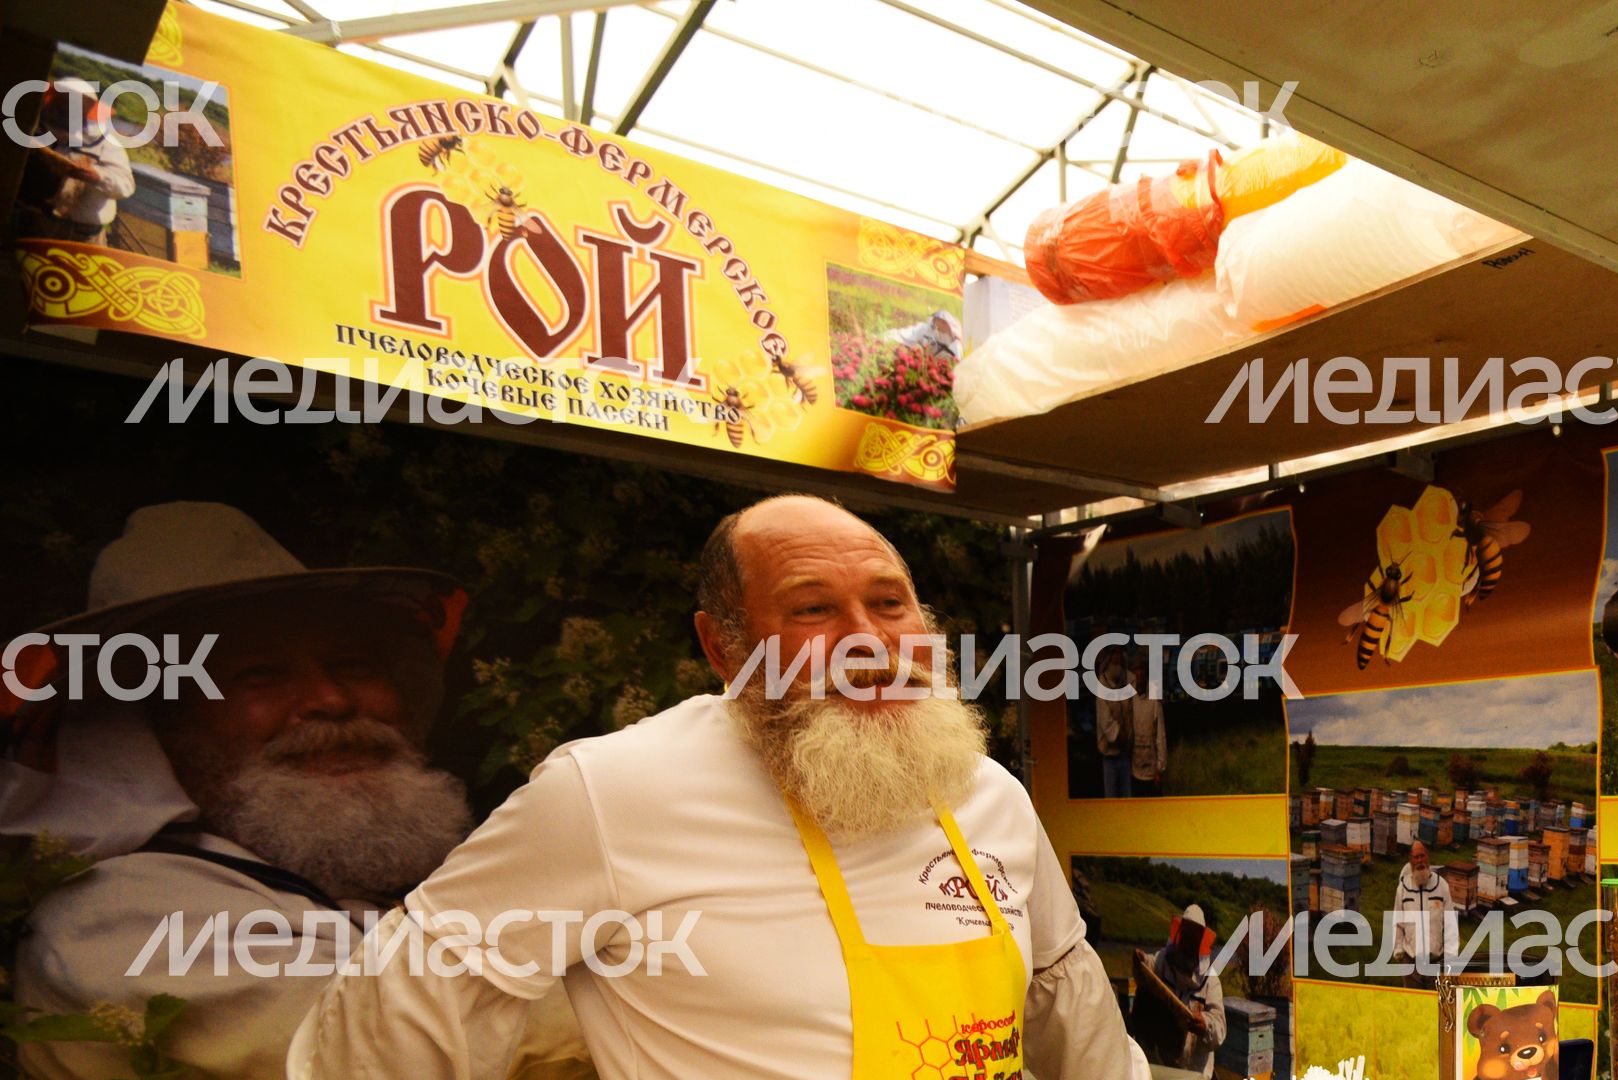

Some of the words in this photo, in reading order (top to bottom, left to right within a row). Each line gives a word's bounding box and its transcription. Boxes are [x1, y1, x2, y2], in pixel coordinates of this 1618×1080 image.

[374, 188, 706, 391] РОЙ
[335, 323, 589, 396] ПЧЕЛОВОДЧЕСКОЕ
[426, 367, 558, 415] КОЧЕВЫЕ
[567, 395, 671, 432] ПАСЕКИ
